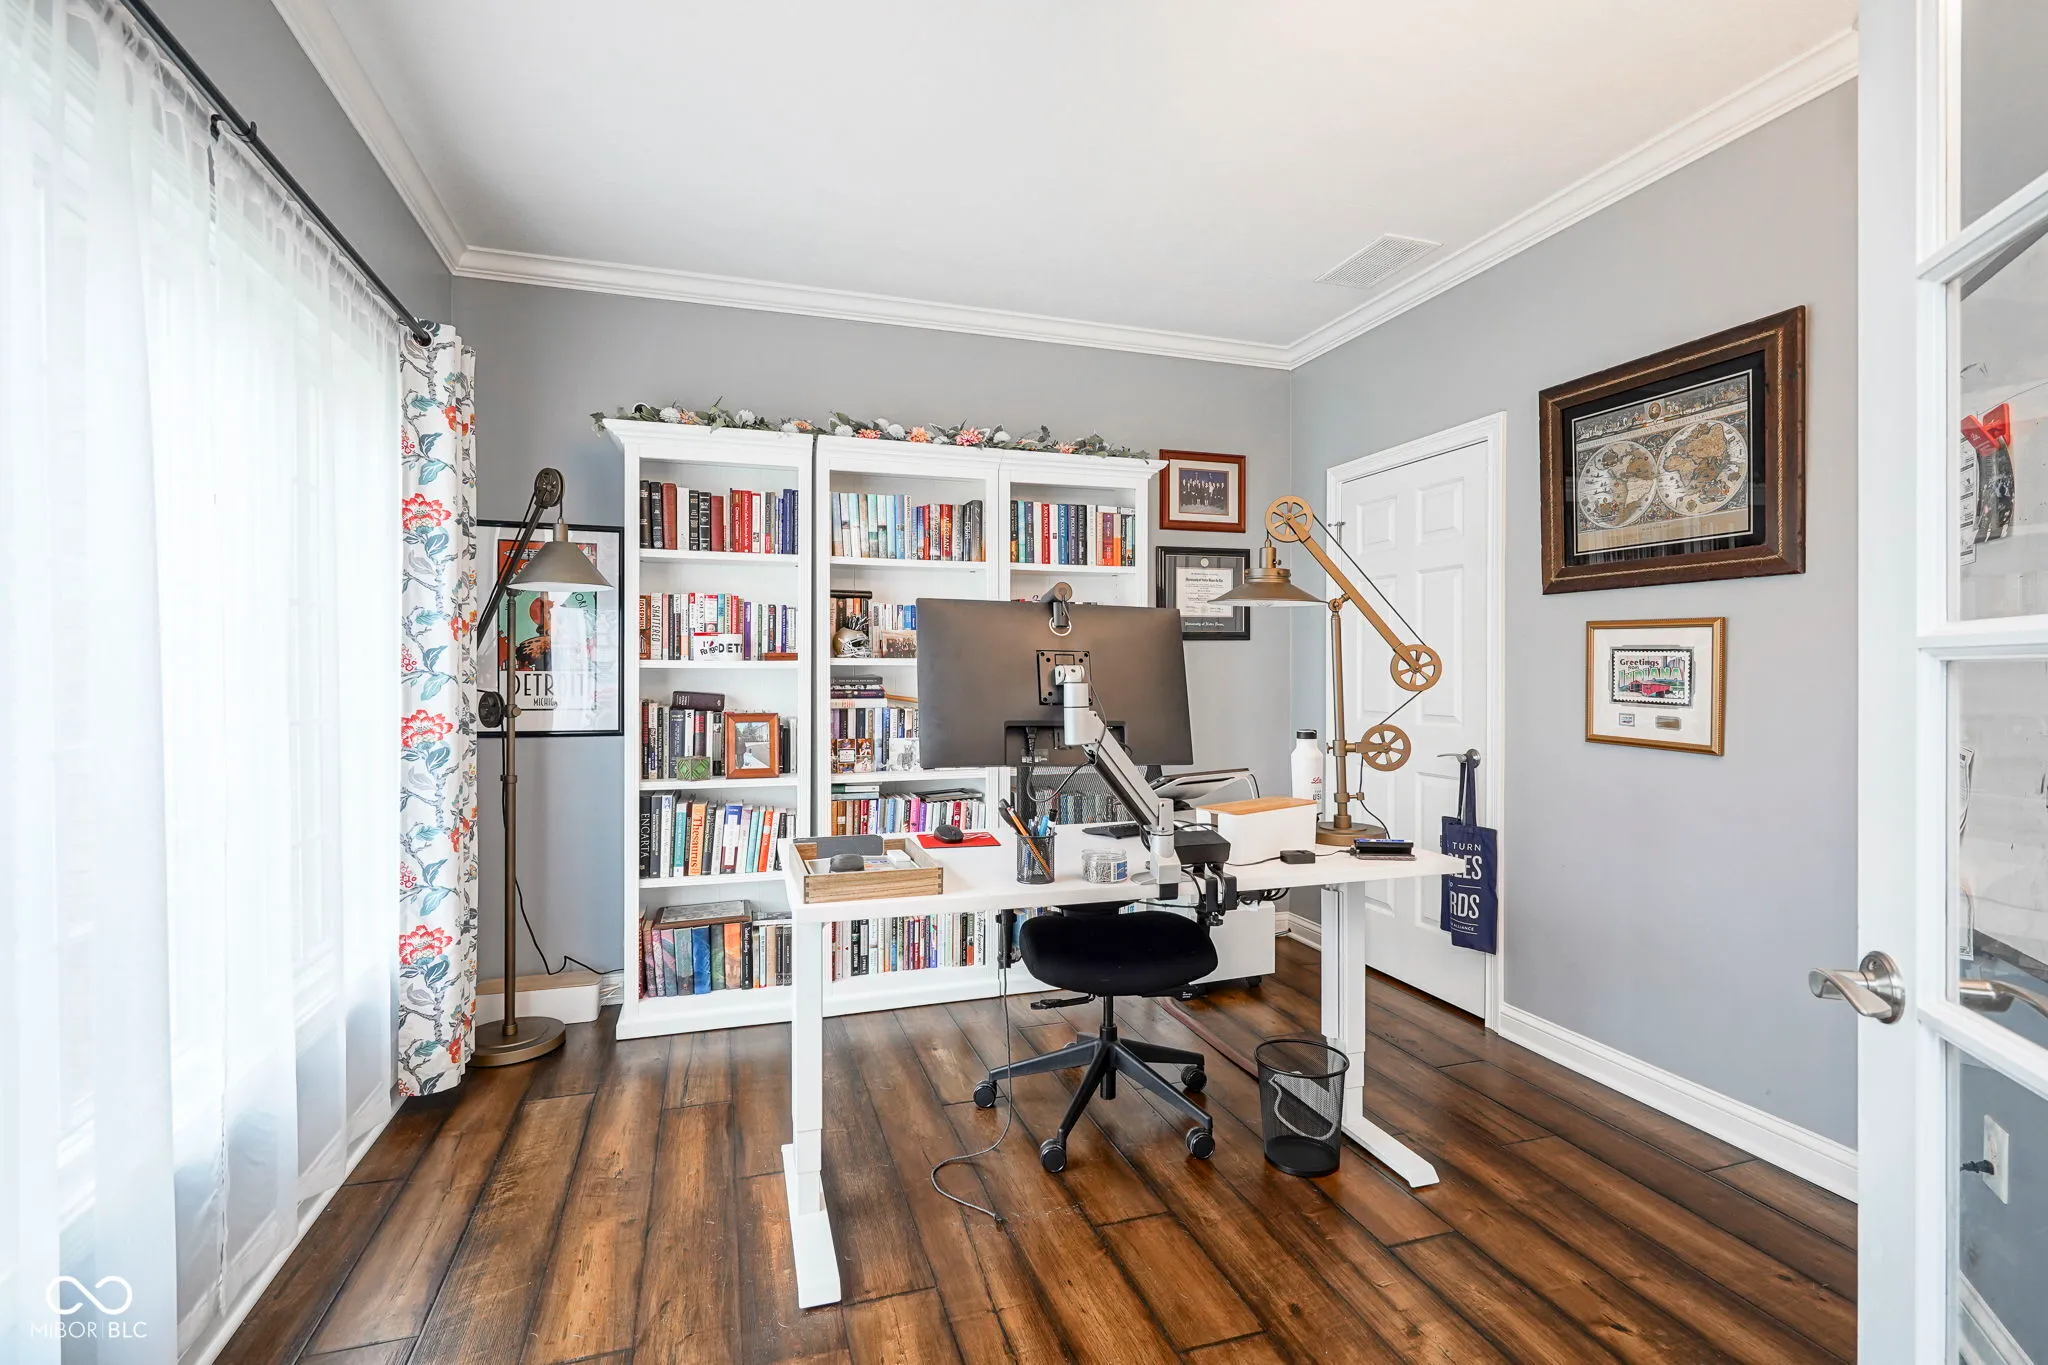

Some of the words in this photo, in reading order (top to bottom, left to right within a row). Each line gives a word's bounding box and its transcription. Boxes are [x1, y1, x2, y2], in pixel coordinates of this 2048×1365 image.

[652, 604, 660, 642] SHATTERED
[1620, 658, 1660, 668] Greetings
[640, 812, 650, 858] ENCARTA
[691, 816, 703, 868] Thesaurus
[1452, 841, 1482, 852] TURN
